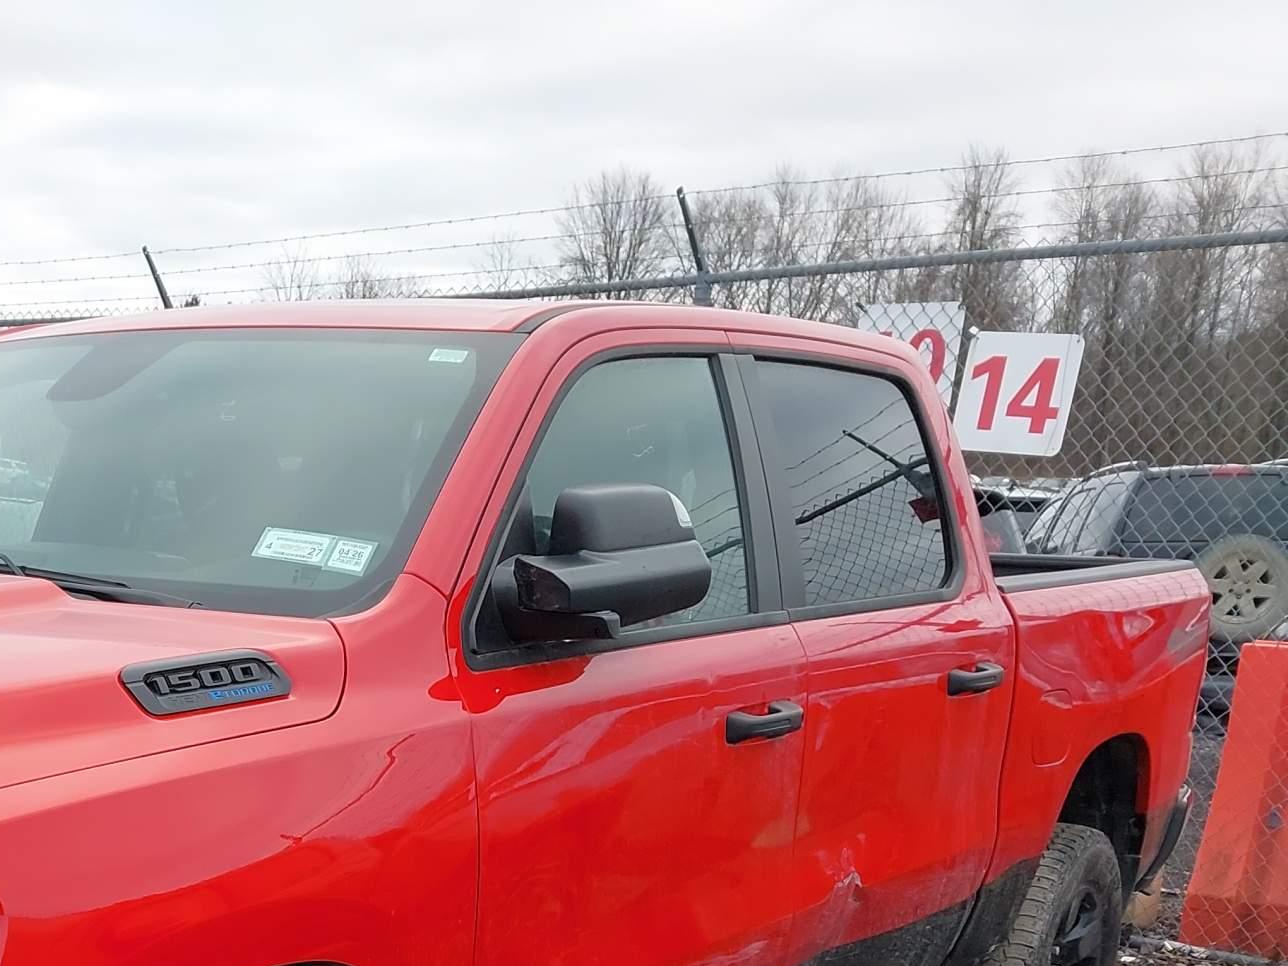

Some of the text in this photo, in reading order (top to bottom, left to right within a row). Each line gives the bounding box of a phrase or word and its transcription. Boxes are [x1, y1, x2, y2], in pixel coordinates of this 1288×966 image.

[971, 356, 1060, 434] 14
[307, 547, 323, 558] 27
[148, 662, 261, 695] 1500
